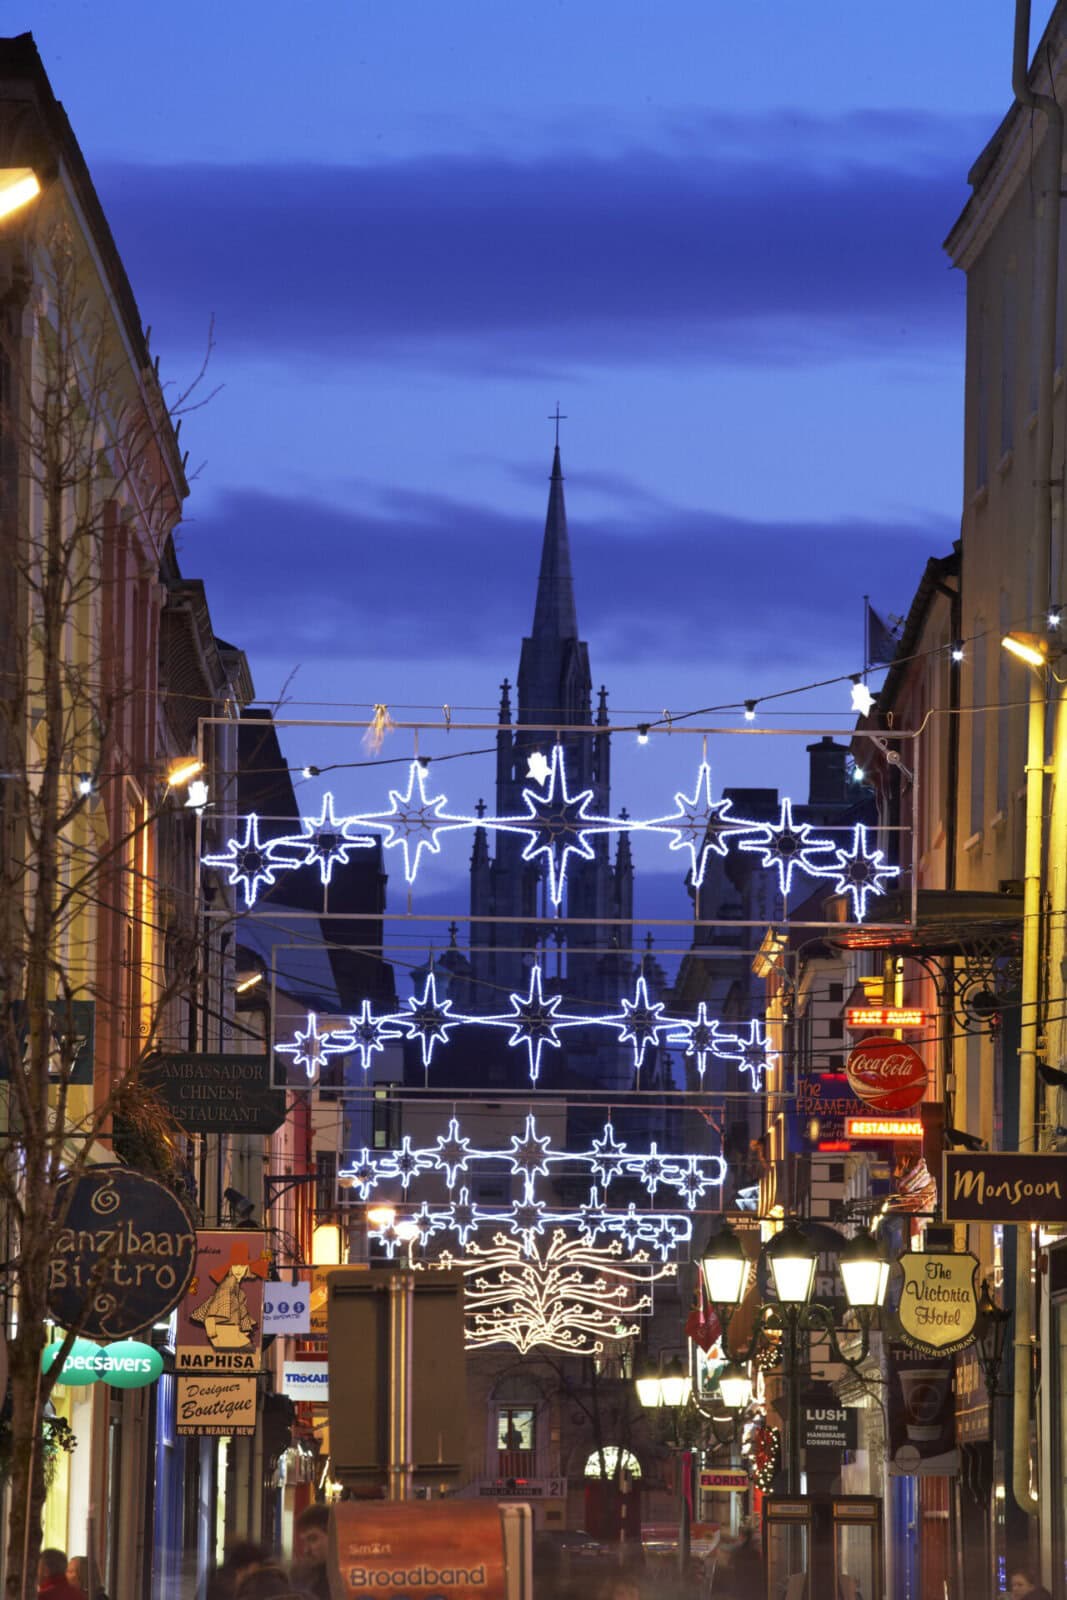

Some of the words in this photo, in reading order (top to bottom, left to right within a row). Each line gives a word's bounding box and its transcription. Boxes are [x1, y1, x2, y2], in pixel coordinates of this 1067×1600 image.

[852, 1011, 881, 1024] TAKE
[886, 1011, 921, 1024] AWAY
[851, 1054, 914, 1077] Coca-Cola
[180, 1085, 244, 1100] CHINESE
[798, 1080, 822, 1096] The
[852, 1122, 923, 1134] RESTAURANT
[954, 1169, 1062, 1206] Monsoon
[50, 1219, 194, 1256] anzibaar
[925, 1263, 952, 1280] The
[906, 1280, 970, 1303] Victoria
[915, 1306, 961, 1325] Hotel
[930, 1333, 976, 1358] RESTAURANT
[180, 1354, 255, 1369] NAPHISA
[186, 1383, 241, 1398] Designer
[181, 1399, 253, 1420] Boutique
[806, 1409, 847, 1421] LUSH
[177, 1426, 194, 1435] NEW
[197, 1426, 203, 1435] &
[205, 1426, 234, 1435] NEARLY
[236, 1426, 254, 1435] NEW
[701, 1475, 748, 1486] FLORIST
[351, 1565, 485, 1587] Broadband
